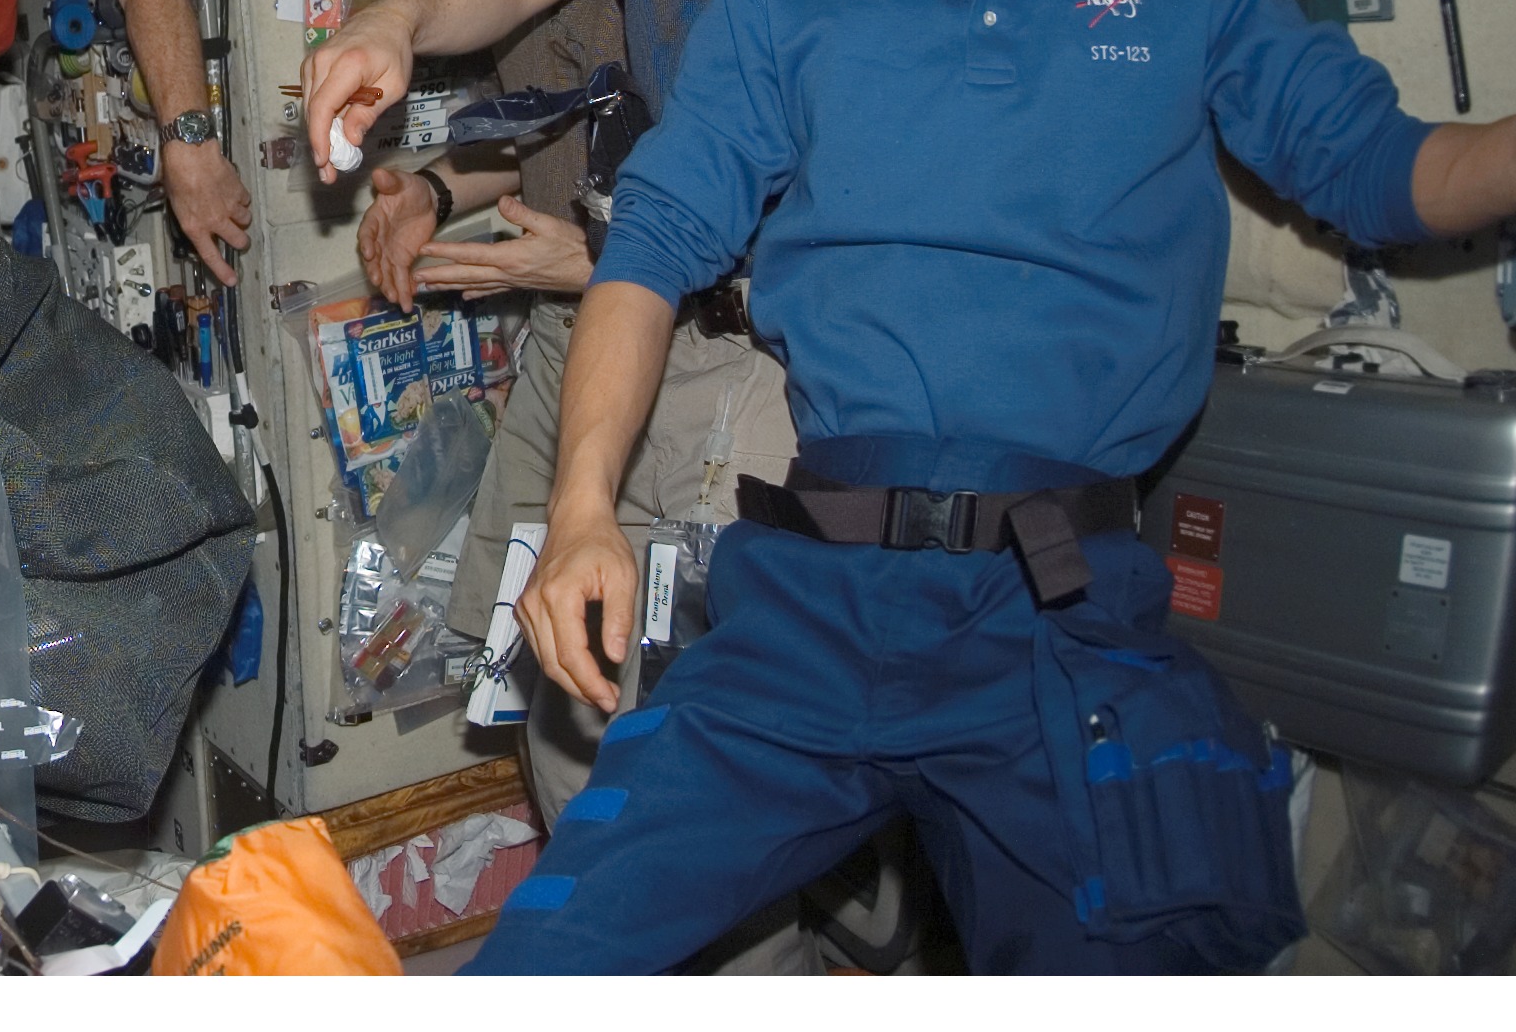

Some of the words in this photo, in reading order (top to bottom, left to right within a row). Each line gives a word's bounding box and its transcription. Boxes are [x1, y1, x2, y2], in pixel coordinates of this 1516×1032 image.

[1090, 45, 1151, 63] STS-123
[410, 103, 425, 112] QTY
[378, 134, 411, 149] TANI
[418, 132, 432, 143] D.
[357, 328, 417, 355] StarKist
[394, 350, 415, 365] light
[433, 370, 477, 393] StarKi
[651, 562, 663, 622] Orange-Mango
[661, 584, 669, 606] Drink
